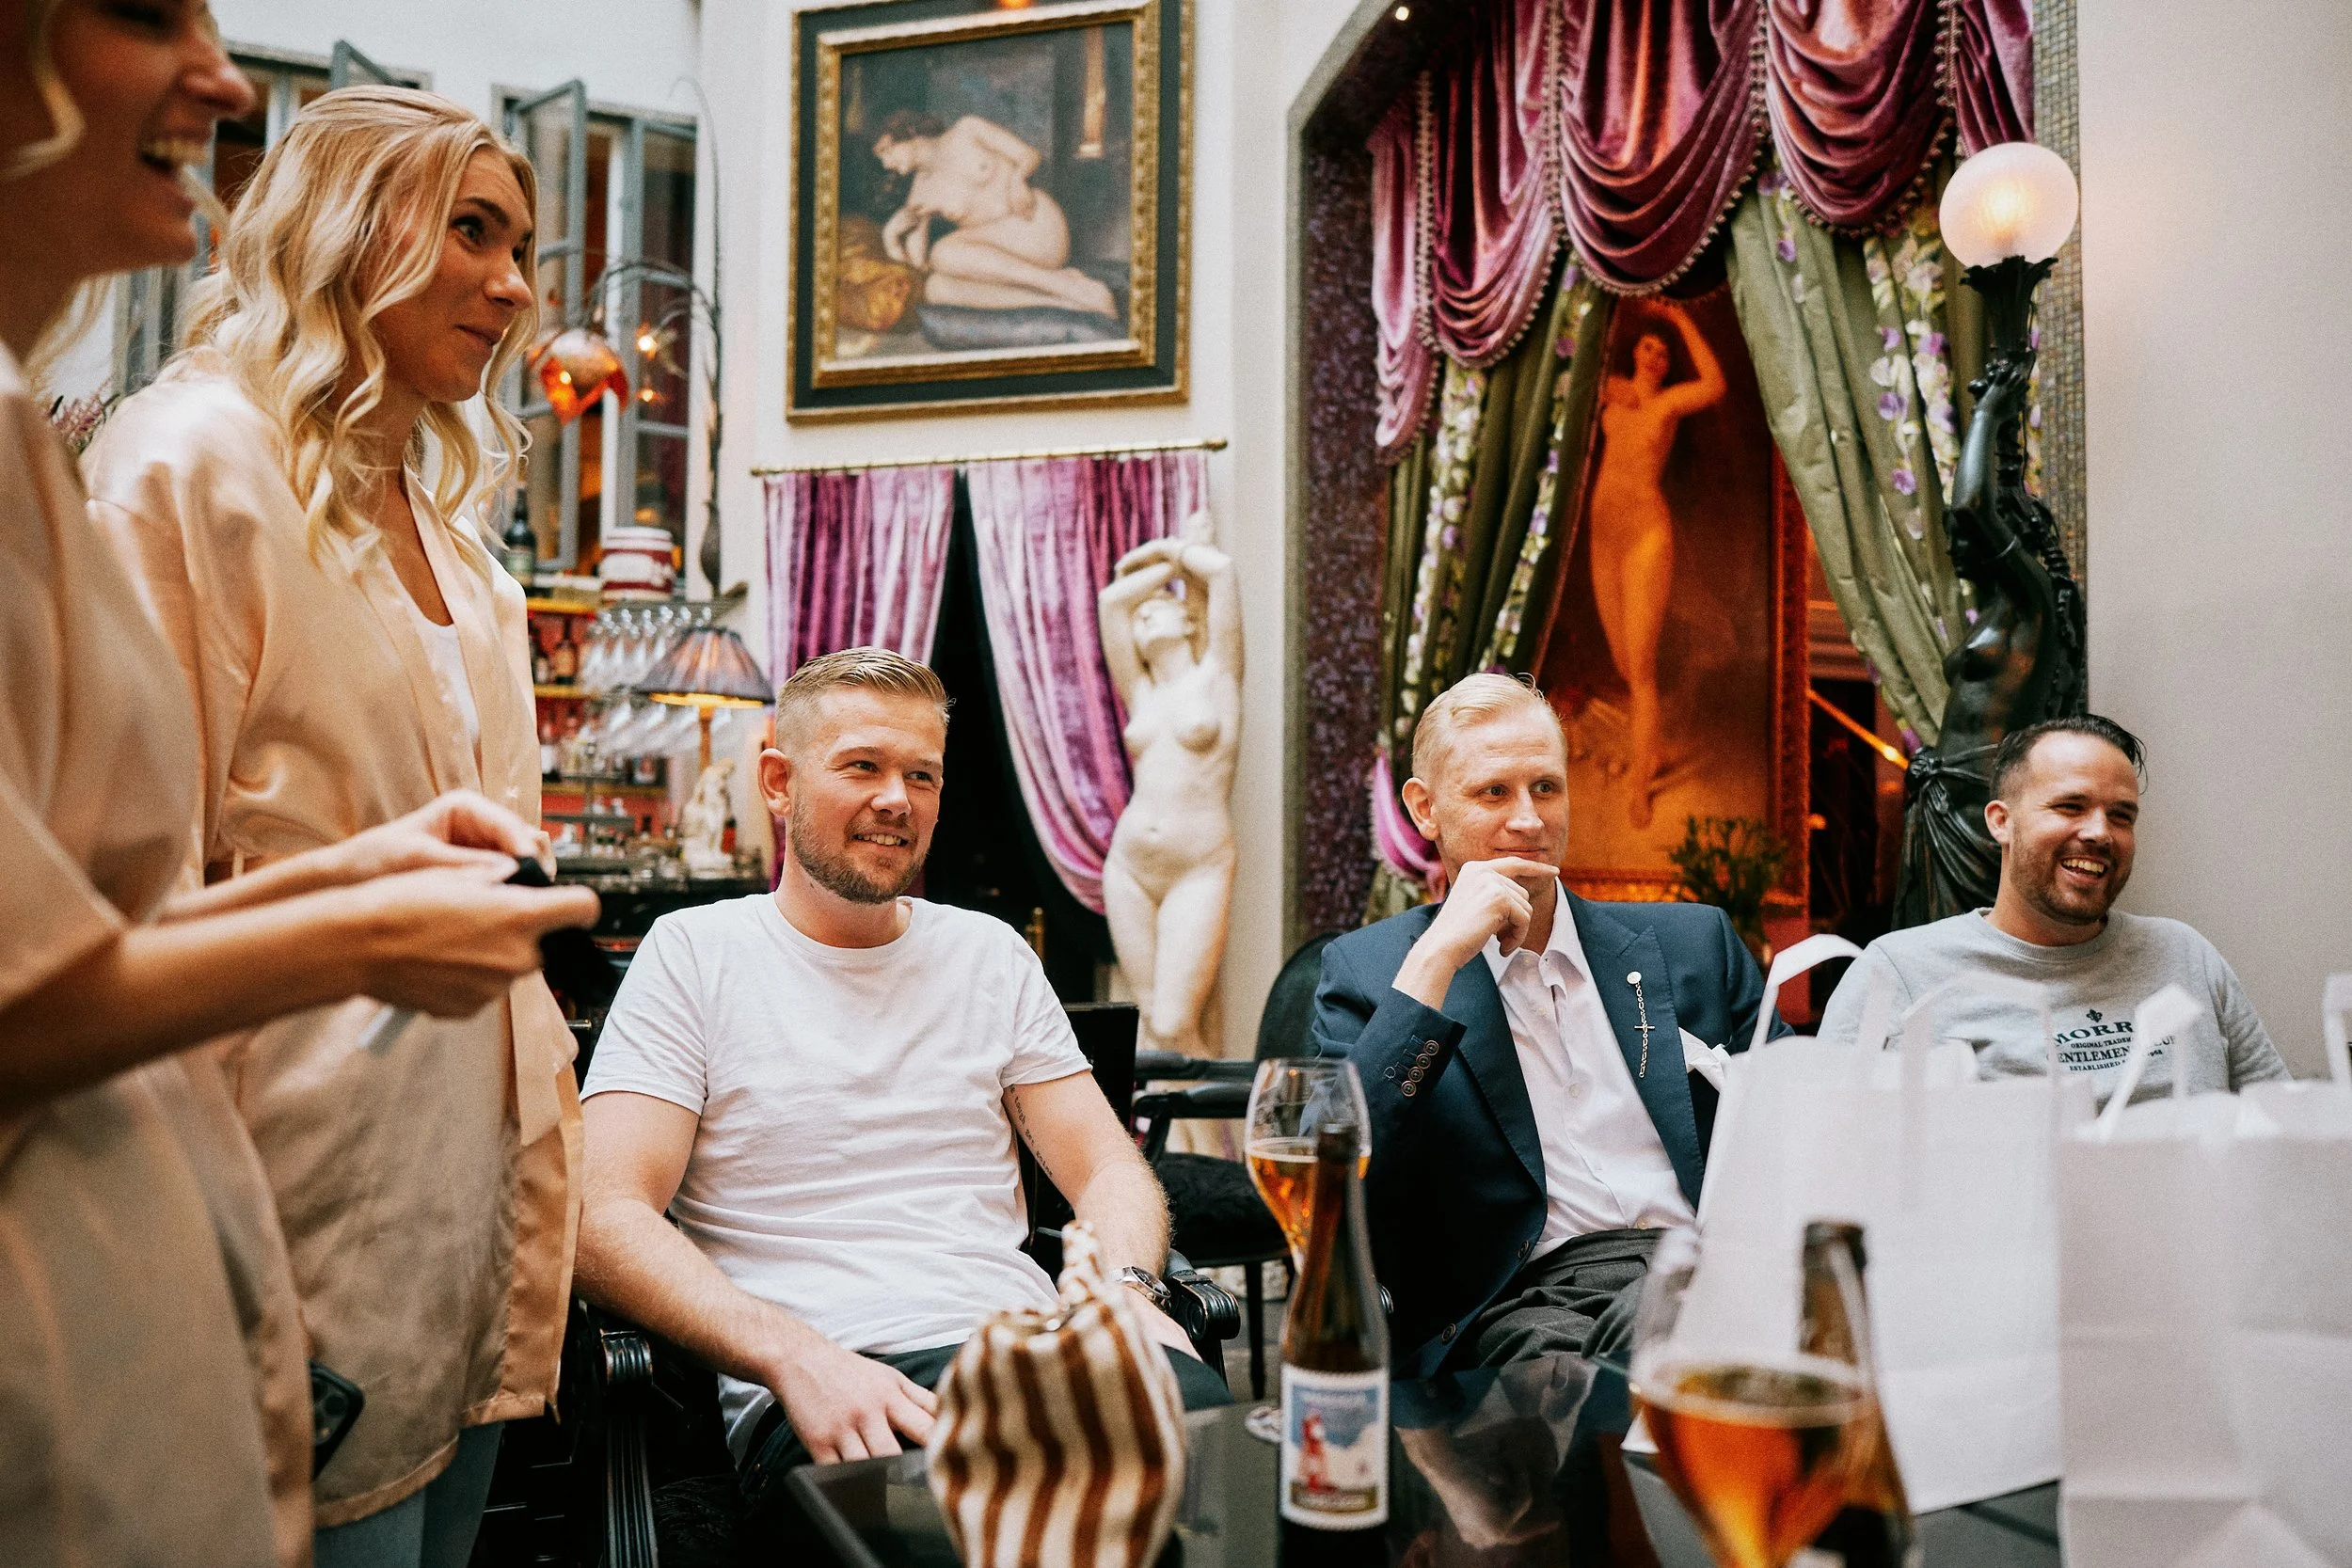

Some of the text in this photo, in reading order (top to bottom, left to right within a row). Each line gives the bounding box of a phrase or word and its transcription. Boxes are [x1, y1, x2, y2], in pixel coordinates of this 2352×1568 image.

[2054, 1021, 2134, 1046] MORR
[2103, 1037, 2133, 1046] TRADEM
[2046, 1046, 2131, 1064] ENTLEMEN
[2070, 1060, 2121, 1072] ESTABLISHED
